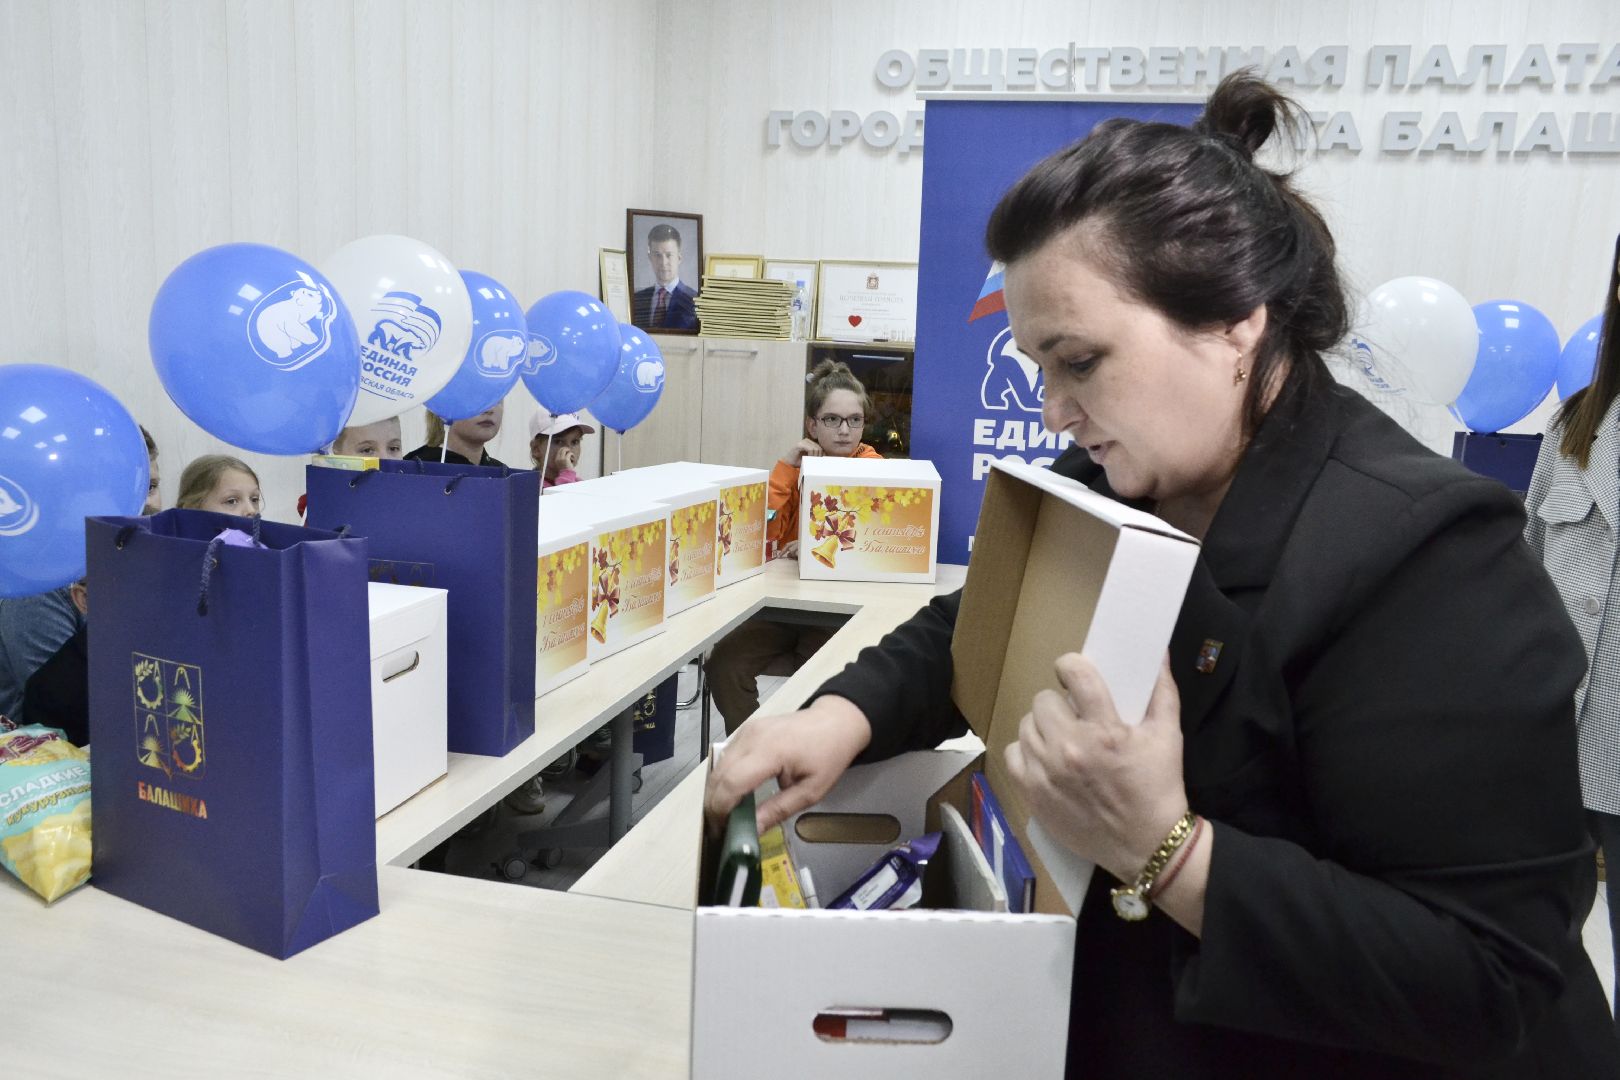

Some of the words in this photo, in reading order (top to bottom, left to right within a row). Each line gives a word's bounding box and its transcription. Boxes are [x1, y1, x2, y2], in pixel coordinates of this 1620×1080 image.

[876, 44, 1348, 91] ОБЩЕСТВЕННАЯ
[360, 344, 418, 376] ЕДИНАЯ
[361, 359, 412, 387] ОССИЯ
[0, 766, 87, 808] СЛАДКИЕ
